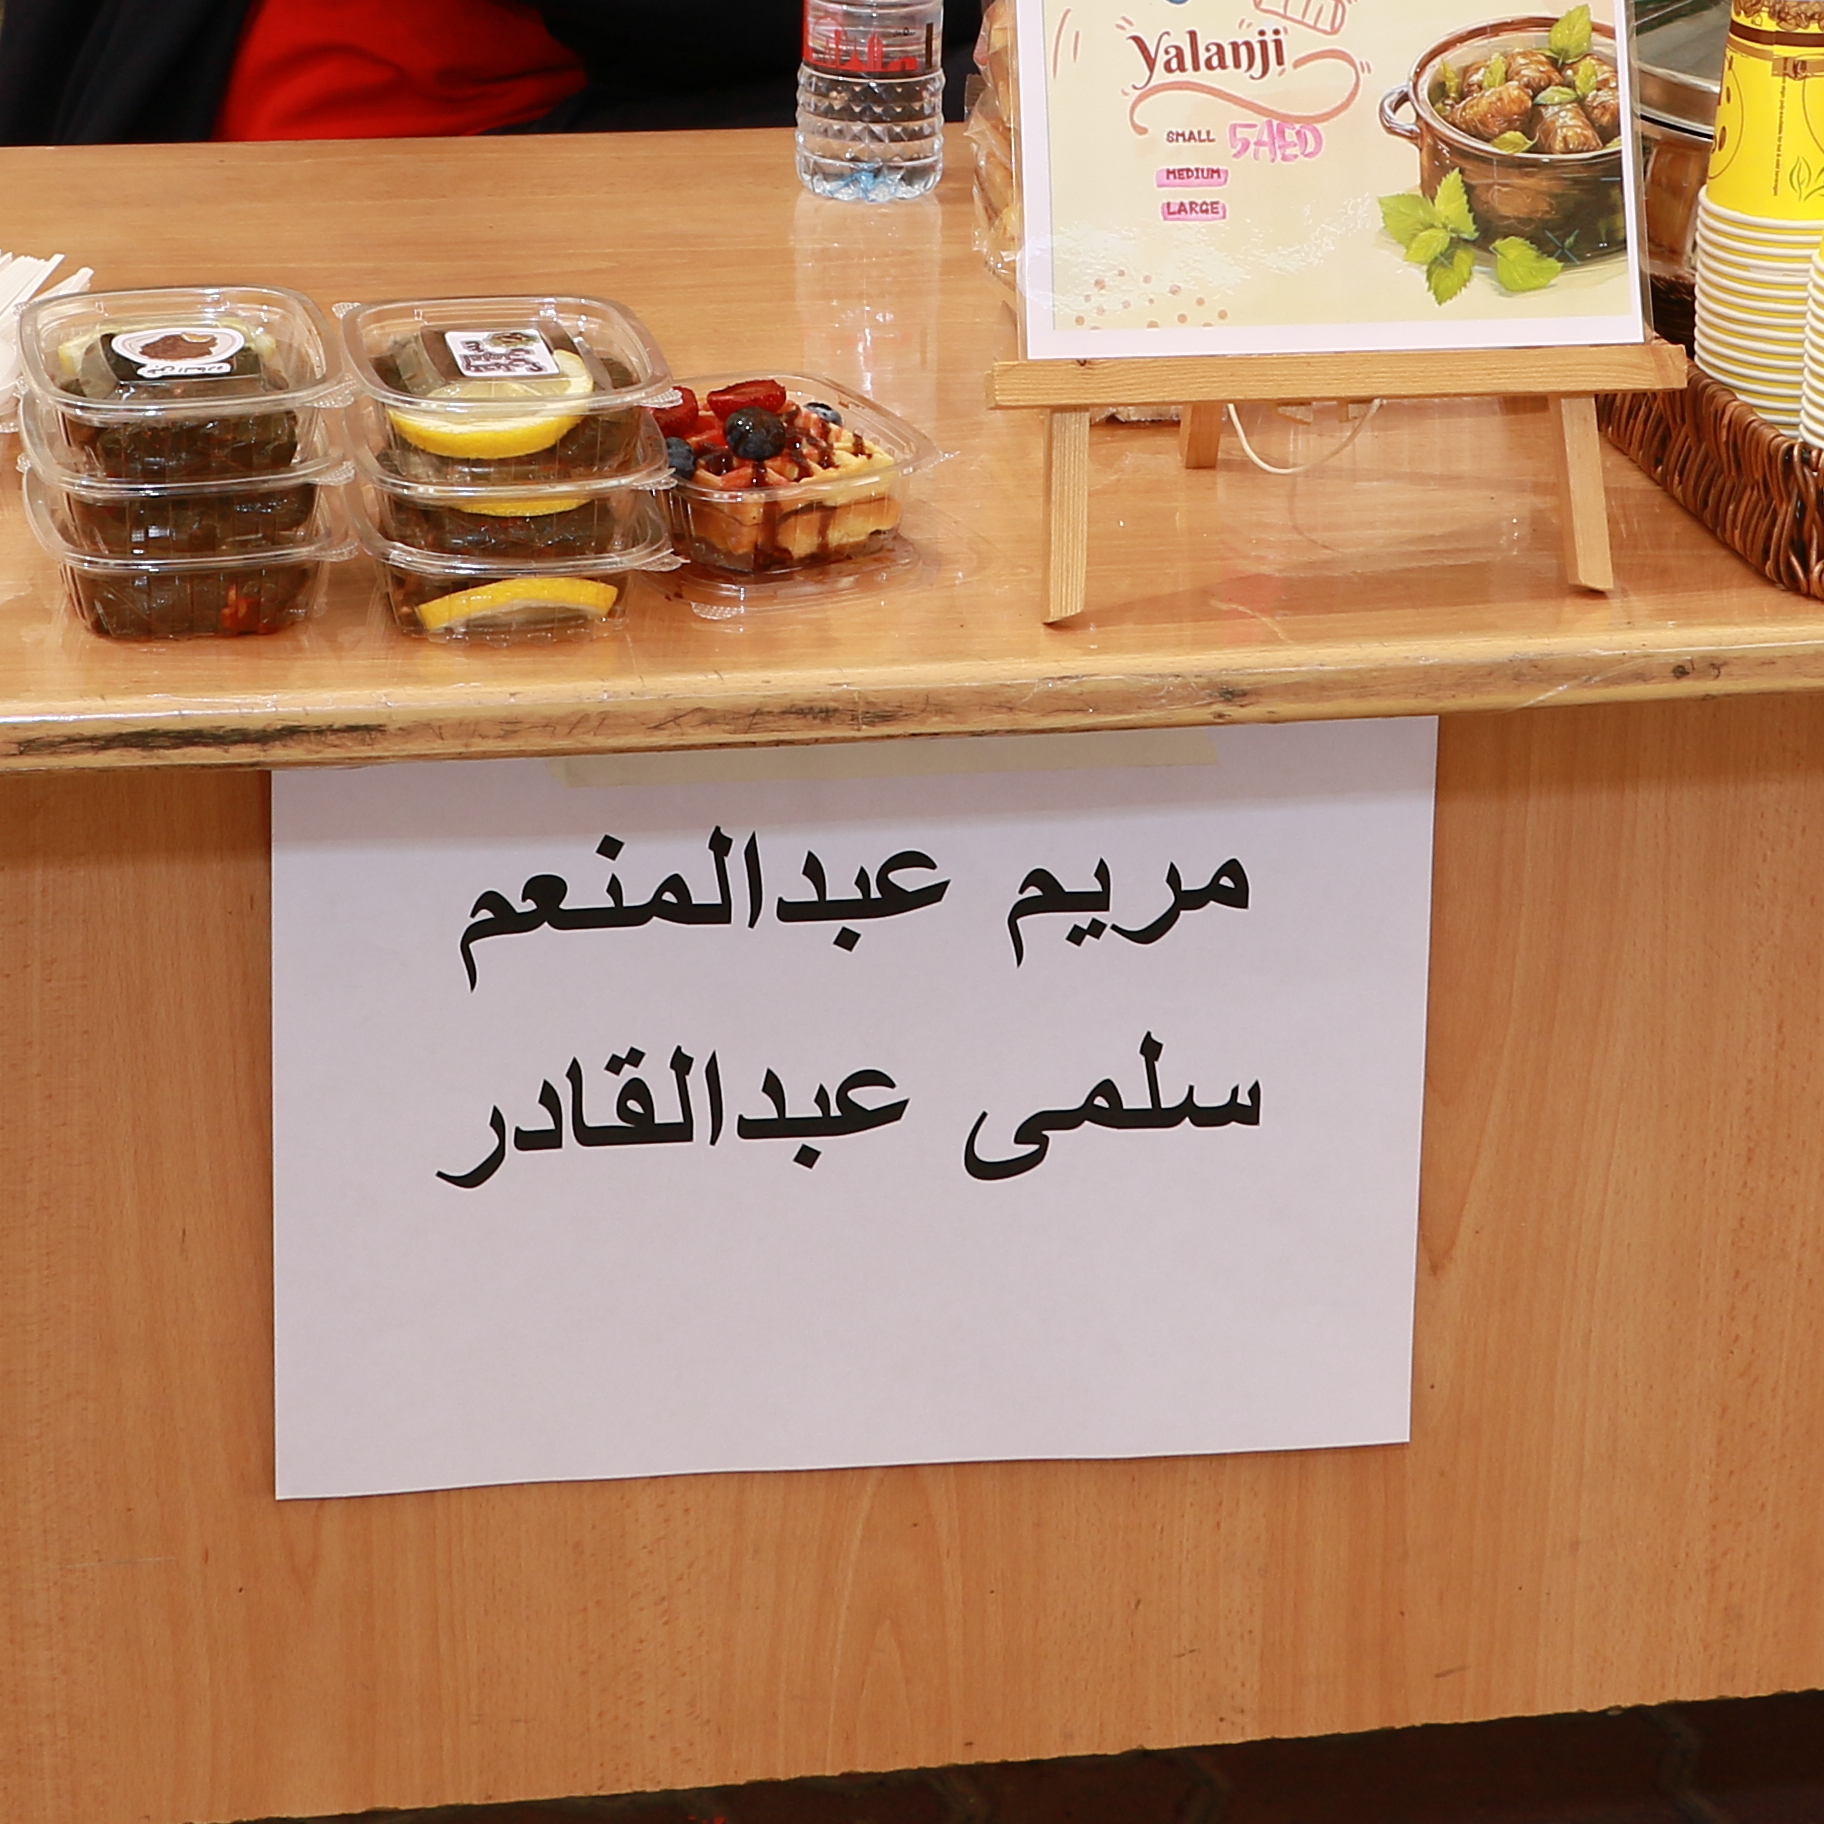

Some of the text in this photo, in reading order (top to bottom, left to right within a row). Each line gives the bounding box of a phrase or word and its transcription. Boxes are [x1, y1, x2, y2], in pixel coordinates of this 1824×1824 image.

[1127, 26, 1287, 91] Yalanji
[1166, 129, 1215, 143] SMALL
[1166, 167, 1221, 180] MEDIUM
[1166, 201, 1220, 215] LARGE
[459, 825, 1250, 992] مريم عبدالمنعم
[436, 1030, 1261, 1188] سلمى عبدالقادر
